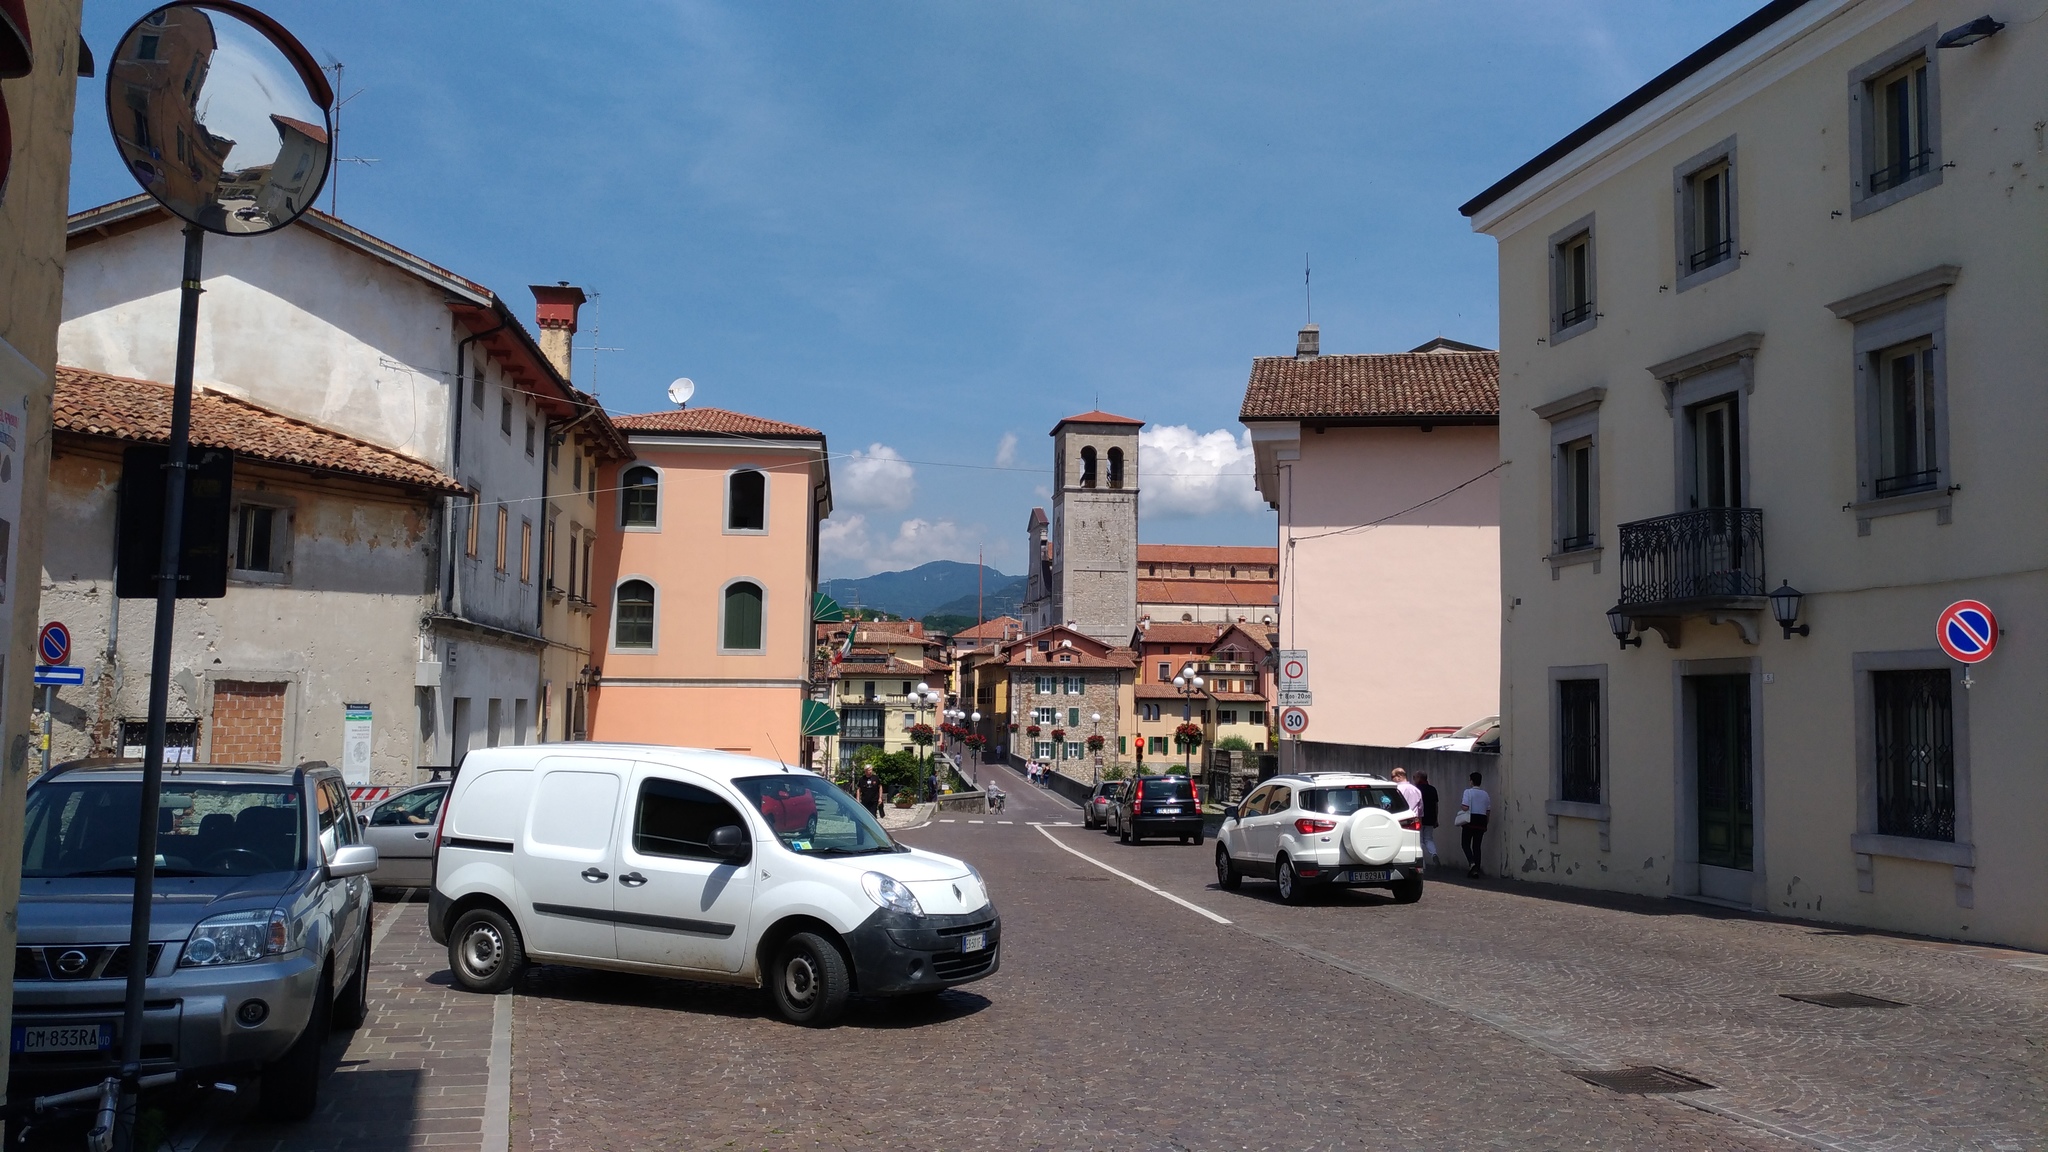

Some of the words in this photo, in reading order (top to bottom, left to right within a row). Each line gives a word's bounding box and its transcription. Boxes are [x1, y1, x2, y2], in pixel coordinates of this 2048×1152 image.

[1287, 714, 1302, 727] 30
[27, 1031, 45, 1047] CM
[50, 1029, 97, 1046] 833RA
[99, 1036, 110, 1046] UD
